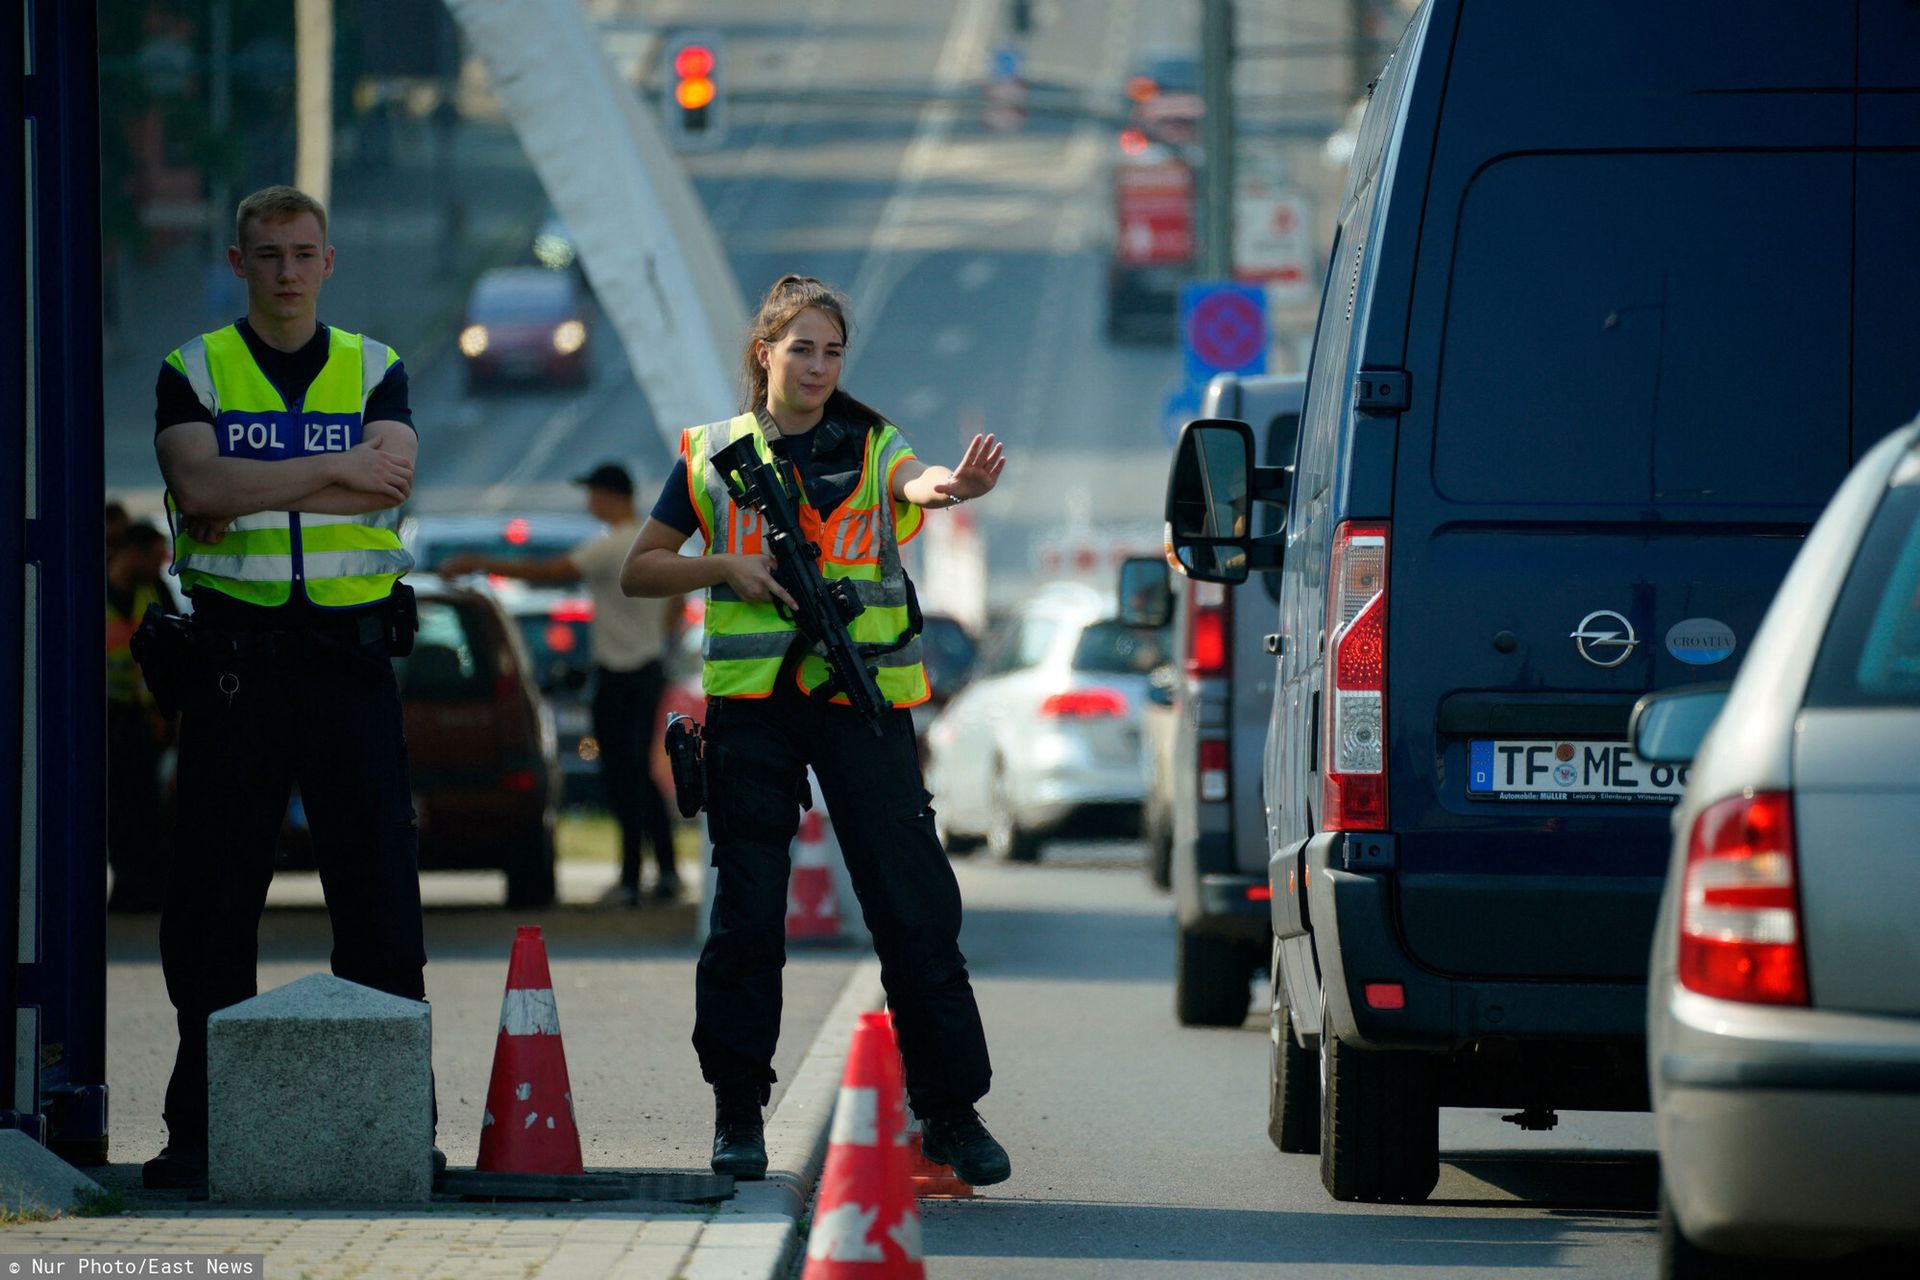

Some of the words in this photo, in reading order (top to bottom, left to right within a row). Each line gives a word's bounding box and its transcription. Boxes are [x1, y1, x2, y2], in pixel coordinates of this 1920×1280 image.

[1673, 636, 1731, 648] CROATIA
[1476, 772, 1486, 783] D
[1498, 746, 1553, 785] TF
[1583, 746, 1639, 787] ME
[1572, 793, 1596, 801] Leipzig
